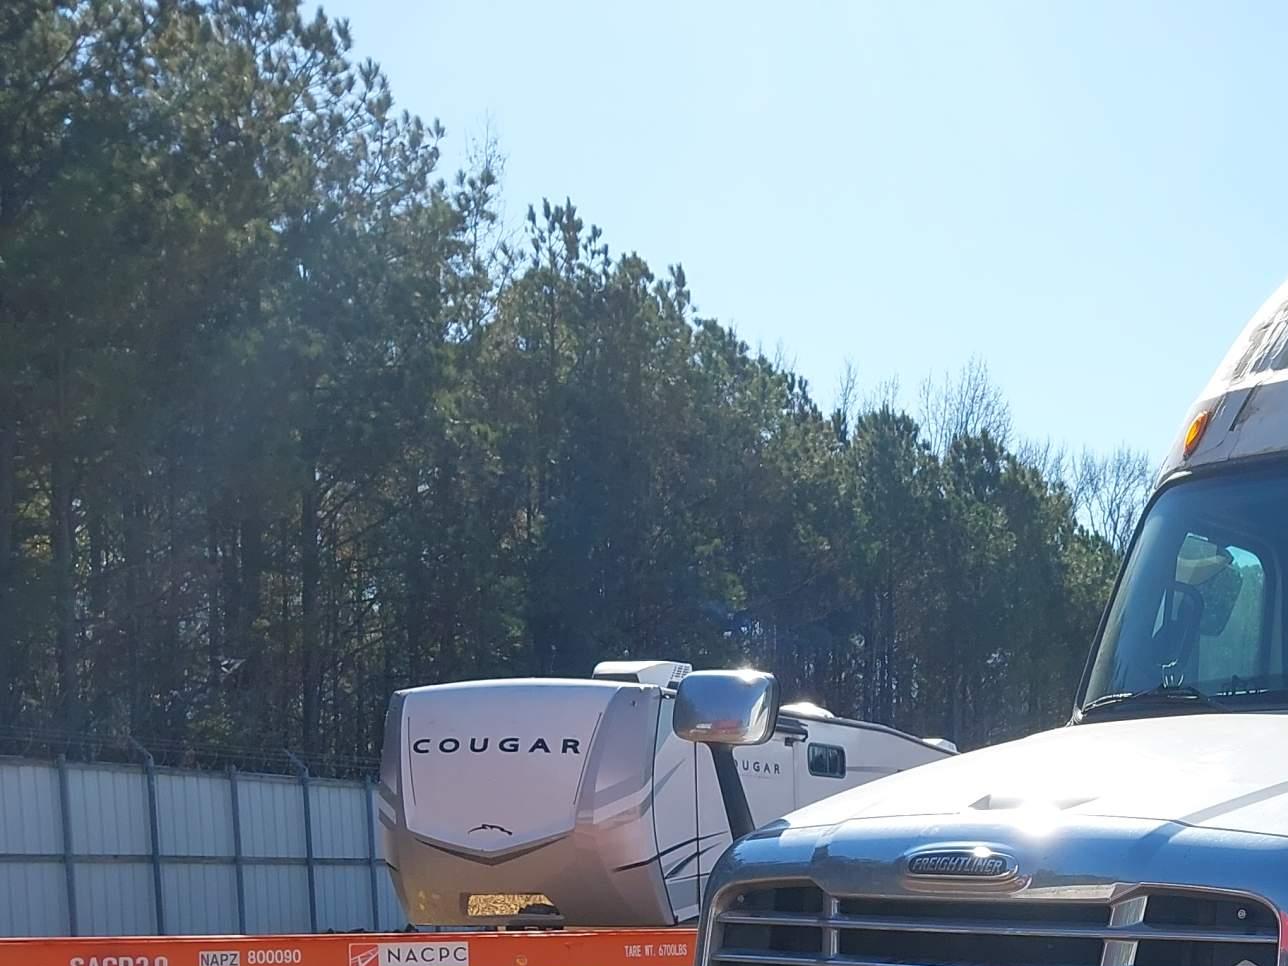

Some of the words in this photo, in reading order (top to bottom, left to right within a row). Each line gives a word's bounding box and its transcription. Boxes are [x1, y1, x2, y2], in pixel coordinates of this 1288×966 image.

[412, 737, 582, 755] COUGAR
[734, 759, 781, 775] UGAR
[912, 855, 1003, 873] FREIGHTLINER
[247, 949, 301, 965] 800090
[387, 946, 468, 962] NACPC
[624, 945, 642, 957] TARE
[644, 945, 656, 957] WT.
[658, 944, 688, 956] 6700LBS
[200, 953, 239, 966] NAPZ
